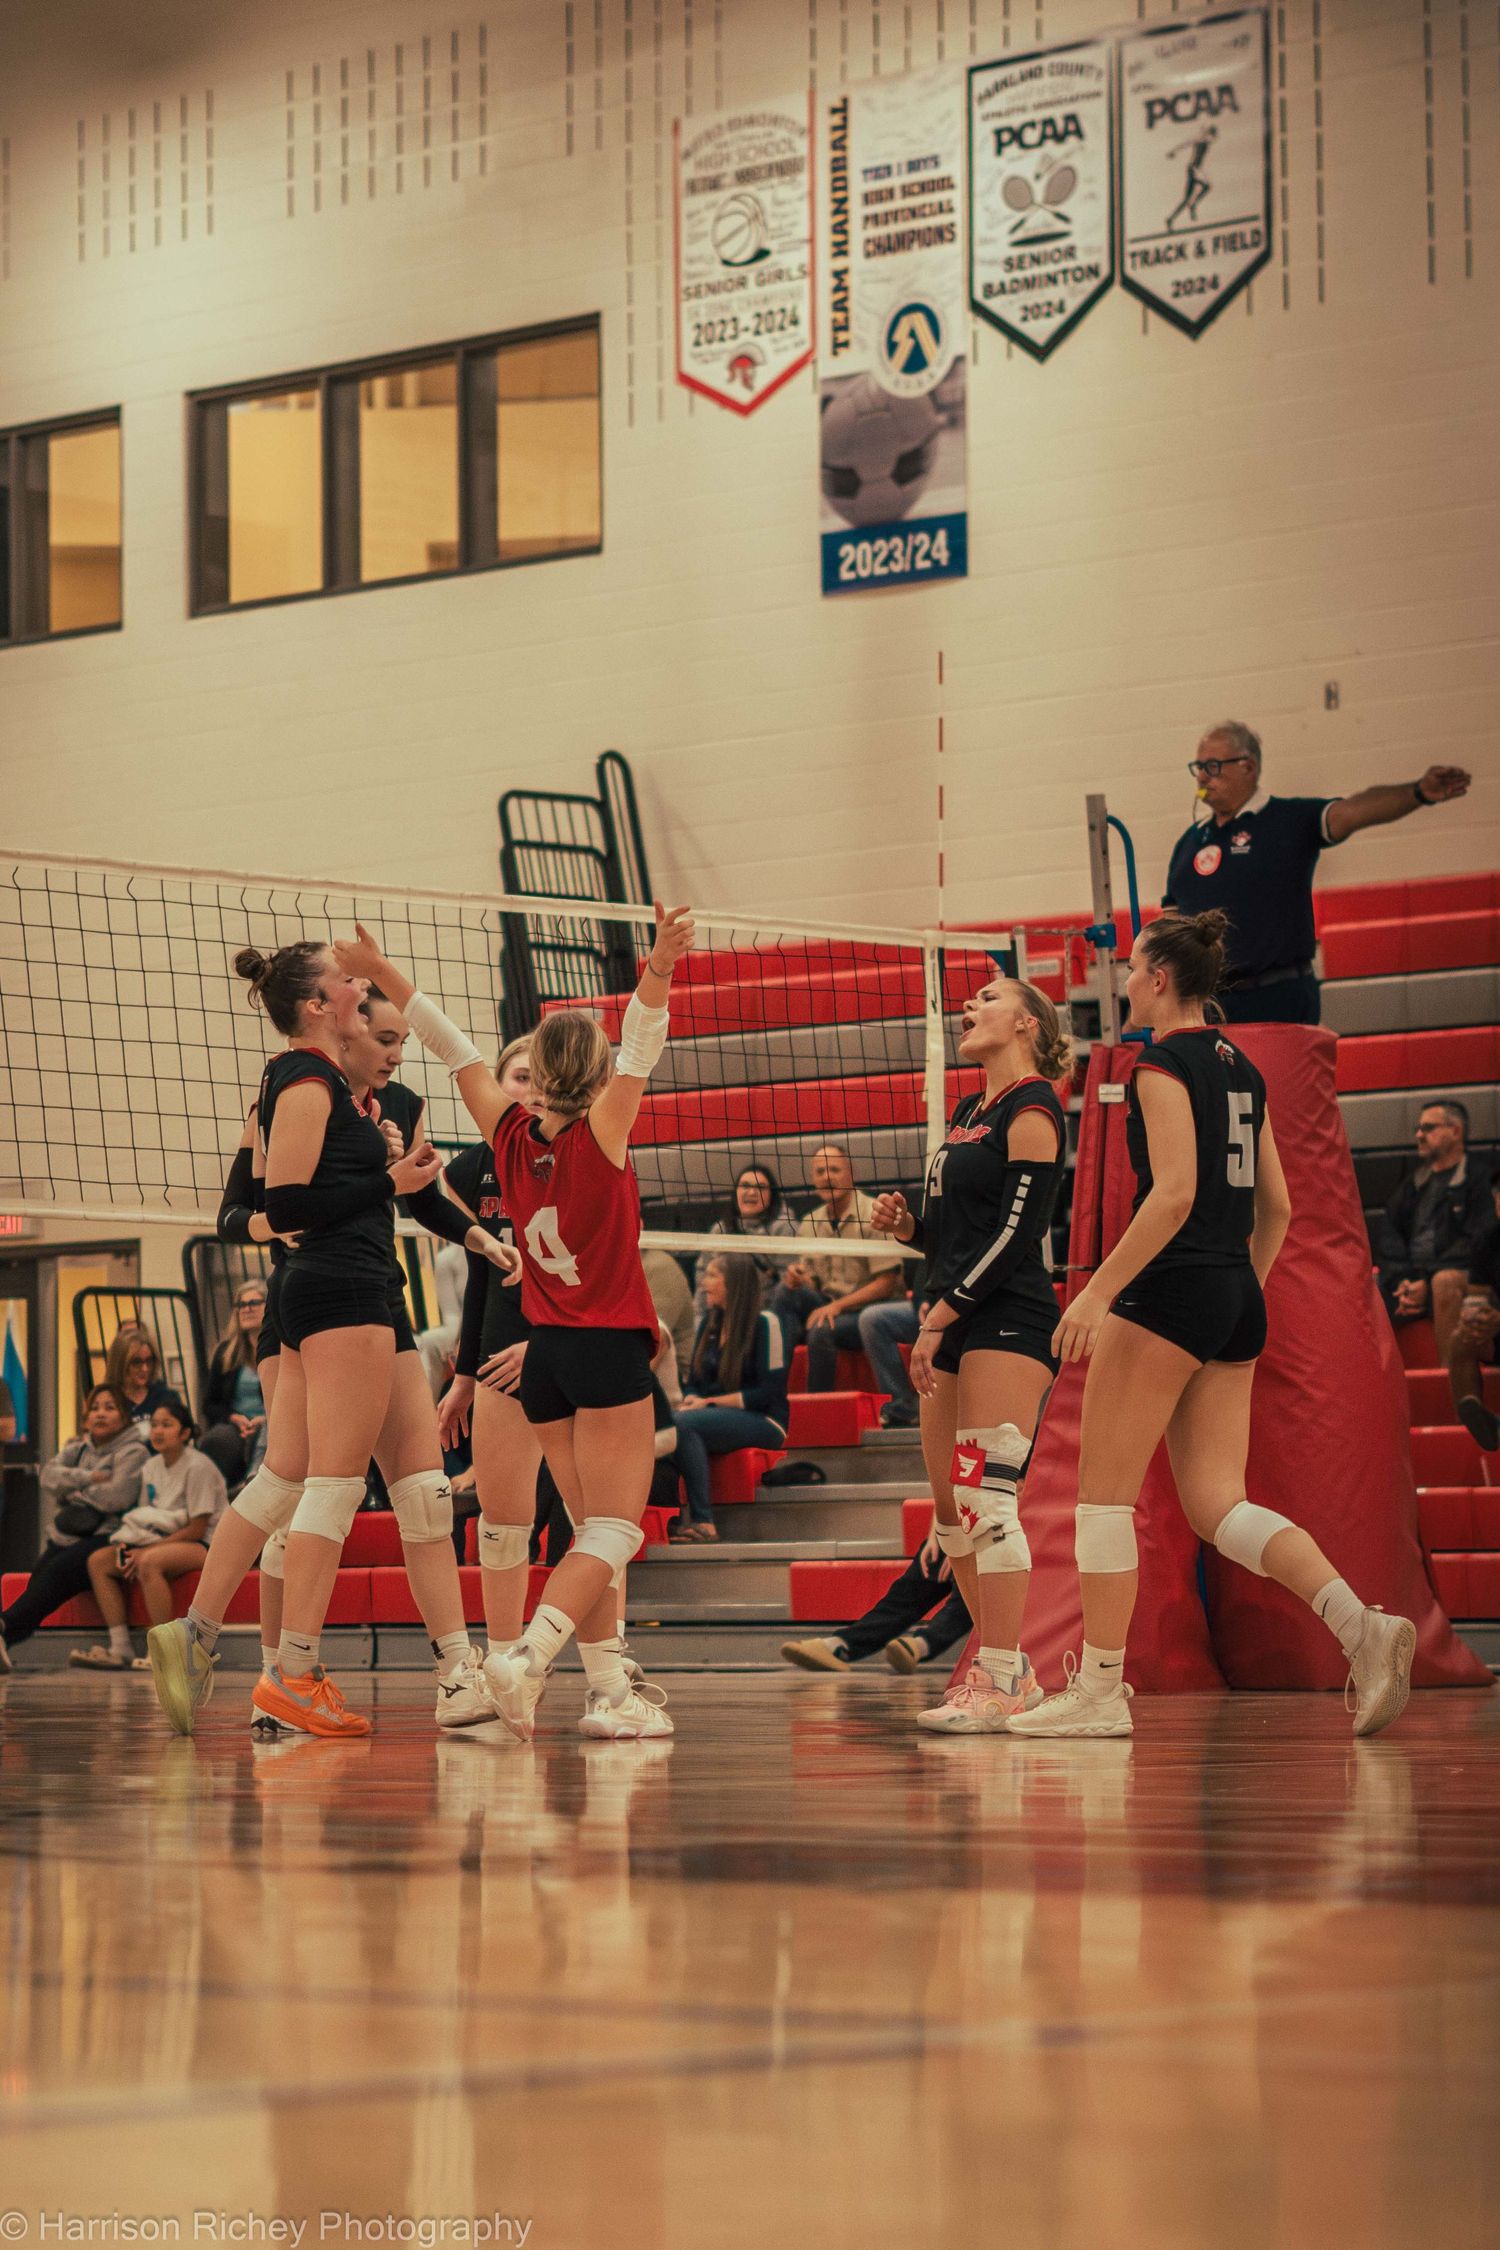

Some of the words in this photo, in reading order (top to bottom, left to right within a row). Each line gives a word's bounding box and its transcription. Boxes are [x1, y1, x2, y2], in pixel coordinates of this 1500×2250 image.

[1144, 83, 1239, 130] PCAA
[992, 113, 1084, 157] PCAA
[830, 96, 849, 260] HANDBALL
[862, 186, 895, 206] HIGH
[901, 175, 955, 200] SCHOOL
[862, 199, 954, 230] PROVINCIAL
[863, 222, 956, 260] CHAMPIONS
[1003, 244, 1077, 273] SENIOR
[1130, 242, 1188, 271] TRACK
[1194, 239, 1206, 258] &
[1212, 228, 1263, 254] FIELD
[683, 274, 748, 301] SENIOR
[755, 262, 808, 288] GIRLS
[983, 261, 1100, 299] BADMINTON
[1171, 273, 1219, 299] 2024
[692, 305, 800, 347] 2023-2024
[832, 267, 850, 357] TEAM
[1019, 297, 1066, 323] 2024
[838, 527, 950, 581] 2023/24
[1227, 1091, 1254, 1188] 5
[524, 1206, 582, 1287] 4
